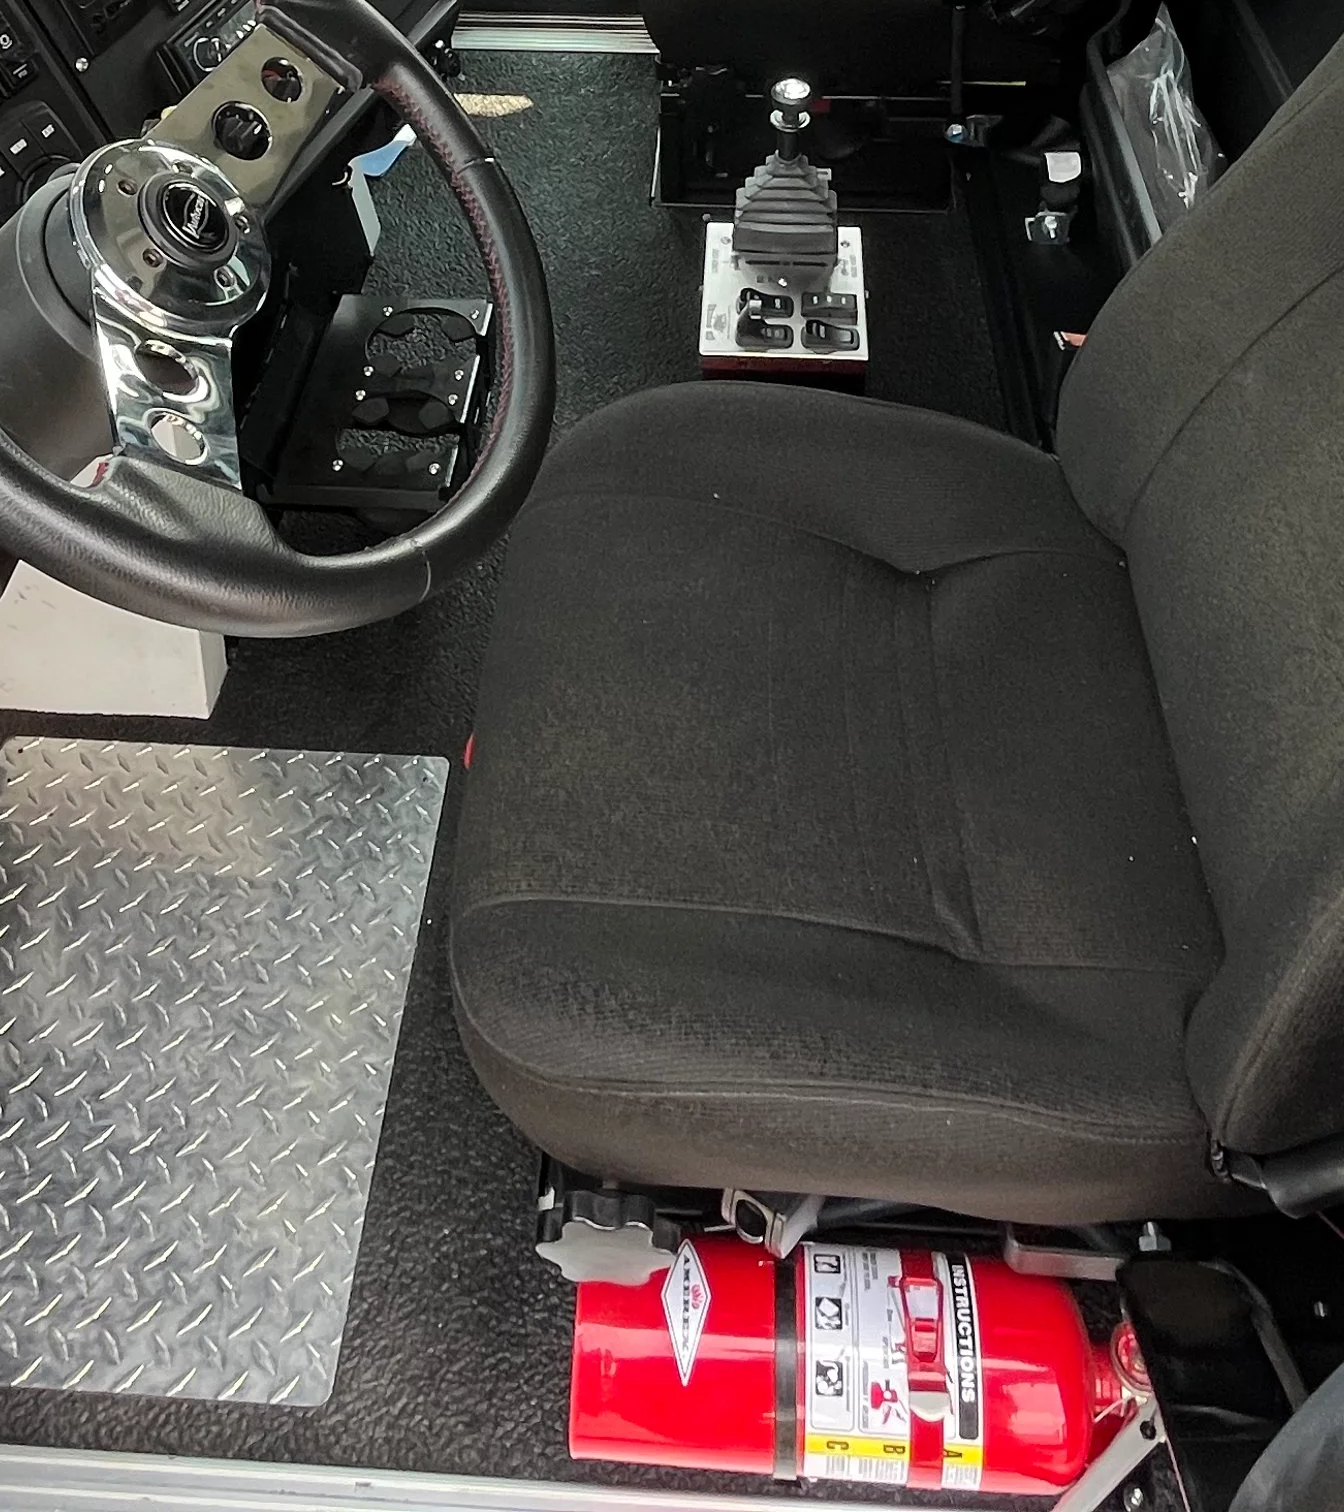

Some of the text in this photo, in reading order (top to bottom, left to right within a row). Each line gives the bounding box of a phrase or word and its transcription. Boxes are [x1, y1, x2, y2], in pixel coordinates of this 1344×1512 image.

[681, 1254, 690, 1349] AMEREX
[952, 1264, 976, 1405] INSTRUCTIONS
[826, 1440, 848, 1450] C
[882, 1444, 905, 1455] B
[943, 1449, 962, 1458] A
